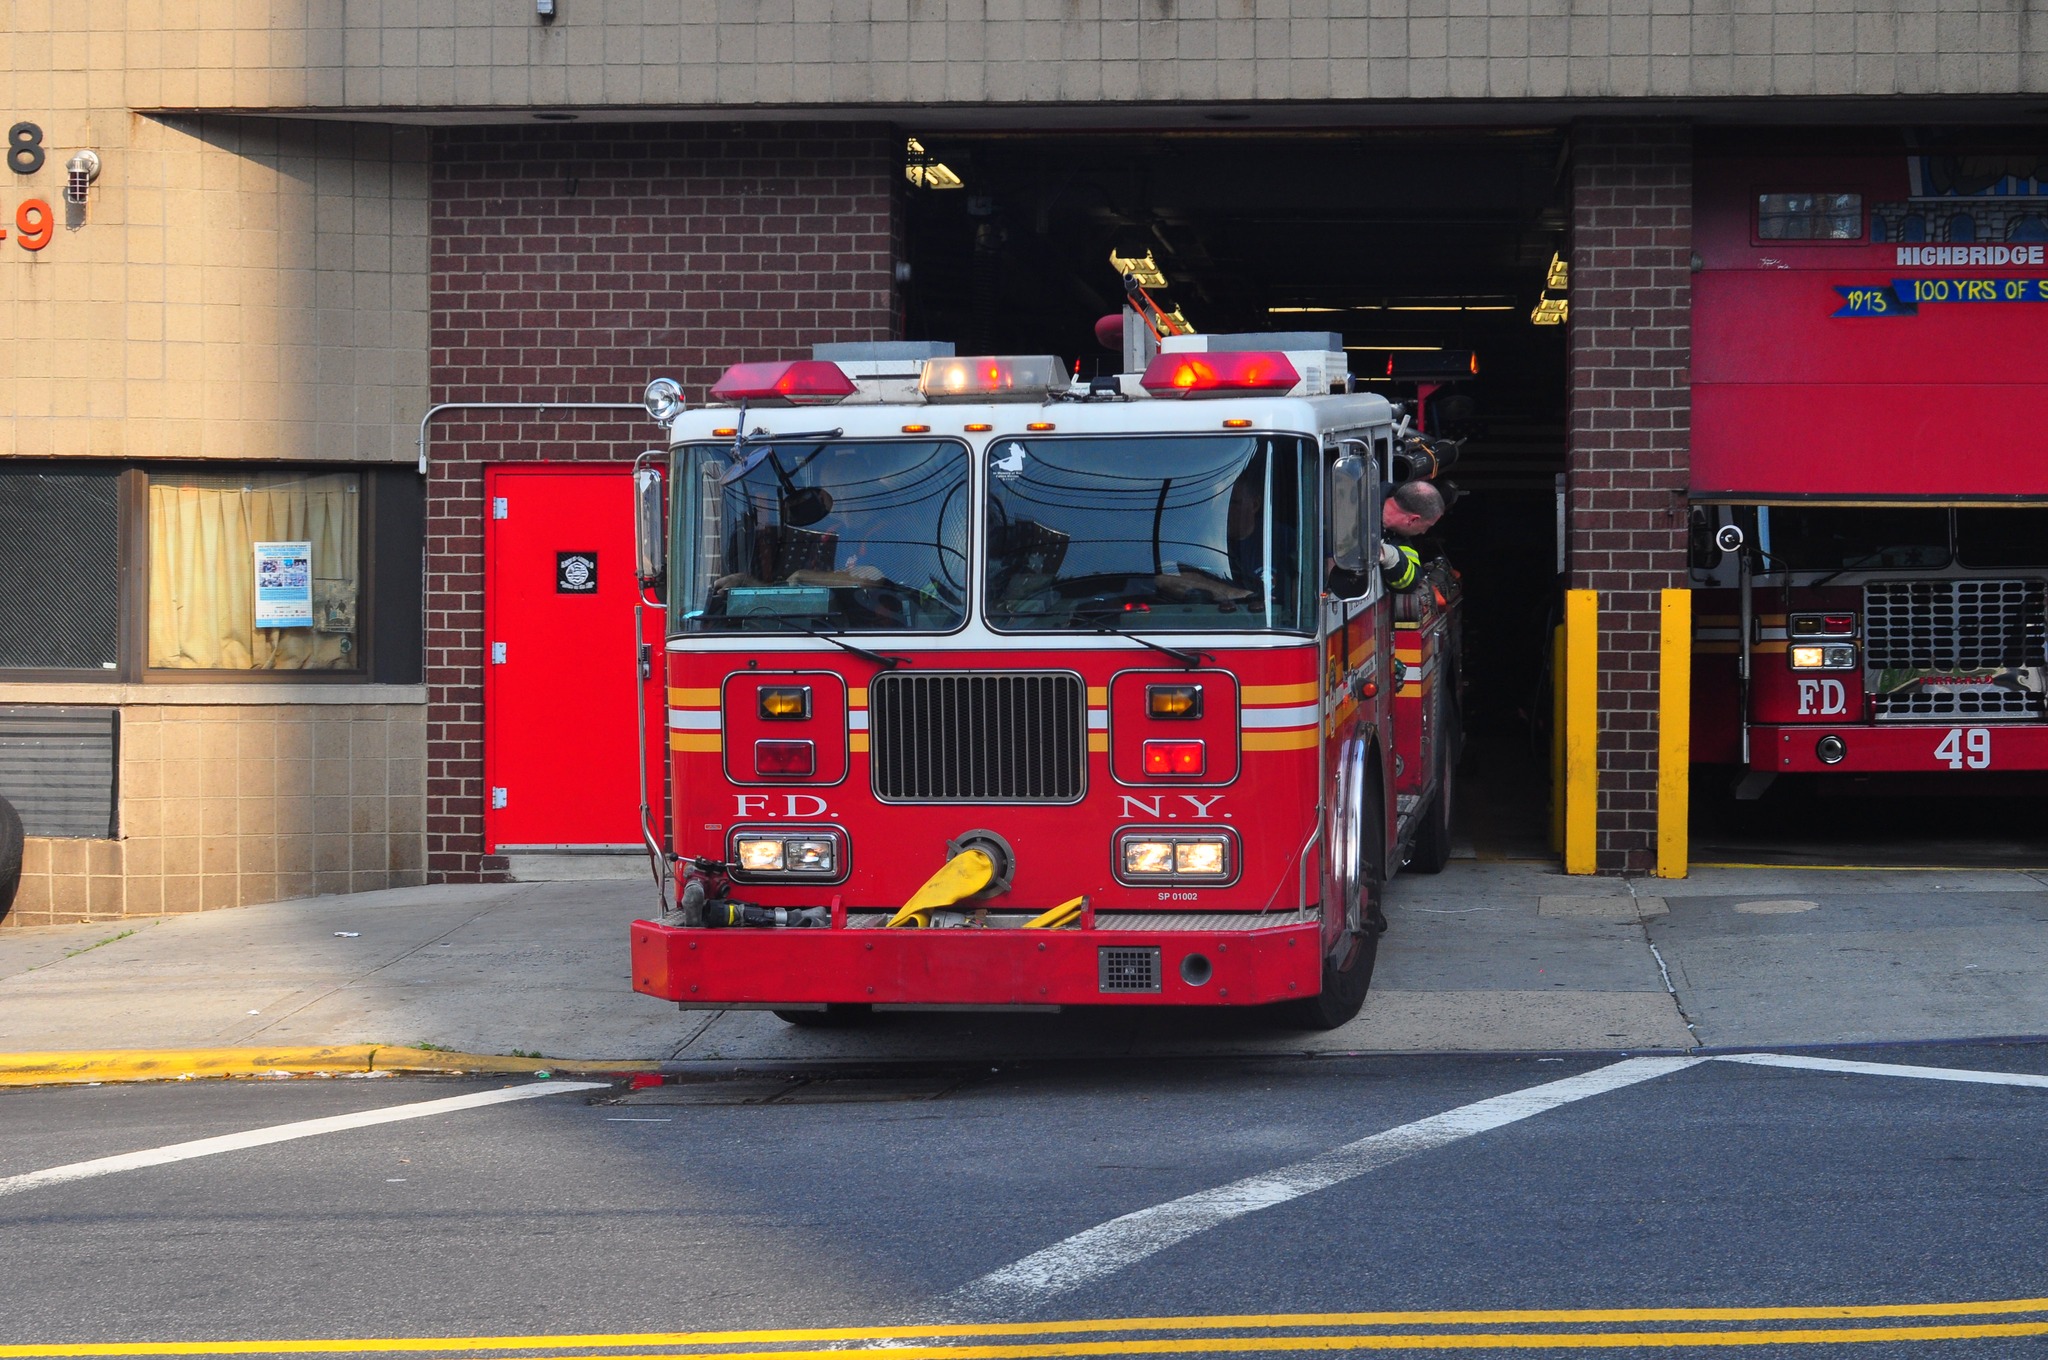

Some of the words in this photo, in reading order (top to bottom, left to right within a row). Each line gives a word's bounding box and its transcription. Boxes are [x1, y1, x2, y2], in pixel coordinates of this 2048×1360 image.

[7, 121, 45, 175] 8
[0, 198, 54, 252] 9
[1896, 246, 2044, 265] HIGHBRIDGE
[1848, 290, 1887, 312] 1913
[1914, 280, 1949, 301] 100
[1953, 280, 1997, 300] YRS
[2005, 280, 2029, 299] OF
[1919, 676, 1983, 685] FERRARA
[1797, 679, 1847, 715] F.D.
[1933, 728, 1991, 769] 49
[732, 794, 840, 817] F.D.
[1117, 794, 1233, 818] N.Y.
[1158, 892, 1170, 900] SP
[1172, 892, 1198, 900] 01002
